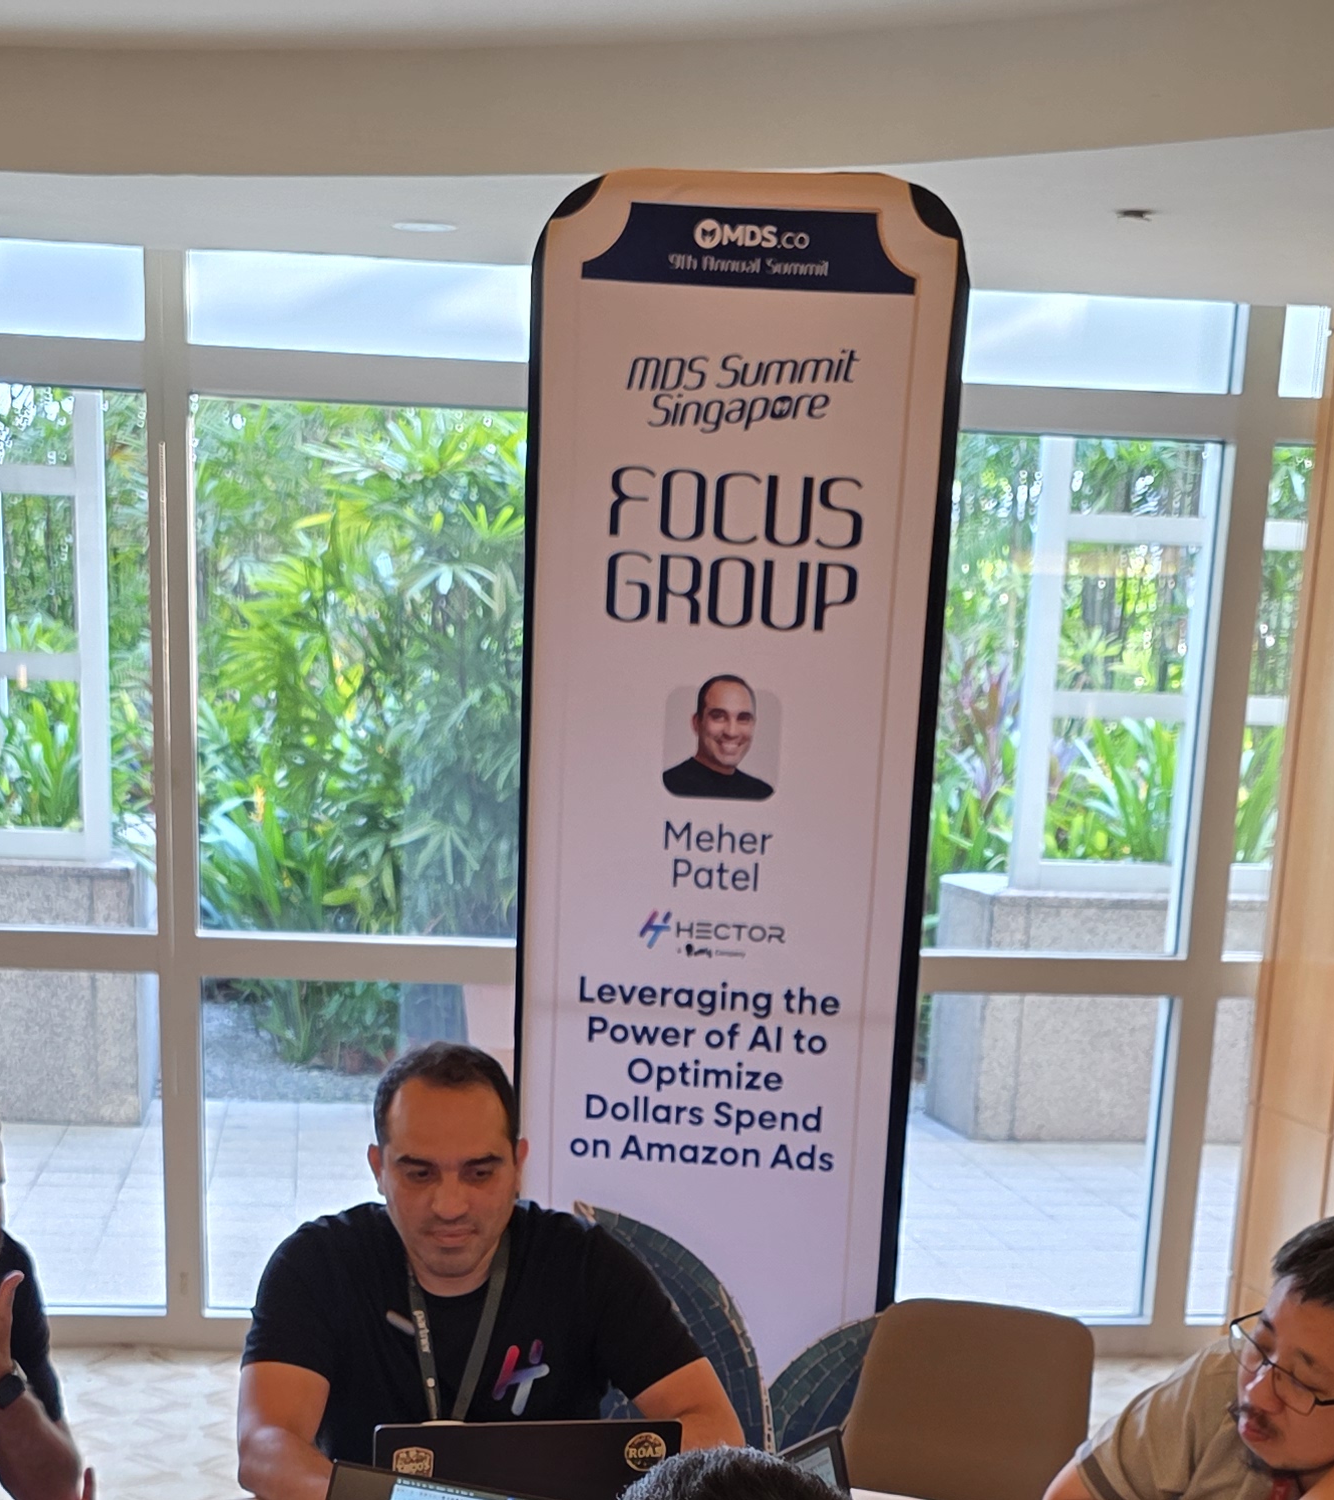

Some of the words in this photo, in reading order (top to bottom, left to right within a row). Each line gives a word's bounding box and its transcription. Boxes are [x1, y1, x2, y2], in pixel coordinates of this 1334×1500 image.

[701, 254, 761, 274] Annual
[765, 257, 830, 277] Summit
[626, 354, 708, 391] MDS
[715, 348, 861, 391] Summit
[646, 392, 832, 434] Singapore
[607, 465, 865, 551] FOCUS
[605, 550, 860, 633] GROUP
[663, 820, 774, 856] Meher
[672, 858, 760, 893] Patel
[676, 921, 786, 944] HECTOR
[578, 975, 774, 1019] Leveraging
[783, 986, 841, 1016] the
[587, 1015, 696, 1049] Power
[704, 1023, 741, 1051] of
[747, 1026, 783, 1054] AI
[793, 1029, 828, 1055] to
[627, 1056, 784, 1092] Optimize
[584, 1093, 705, 1127] Dollars
[713, 1100, 823, 1136] Spend
[569, 1135, 611, 1160] on
[620, 1134, 761, 1169] Amazon
[770, 1144, 836, 1173] Ads
